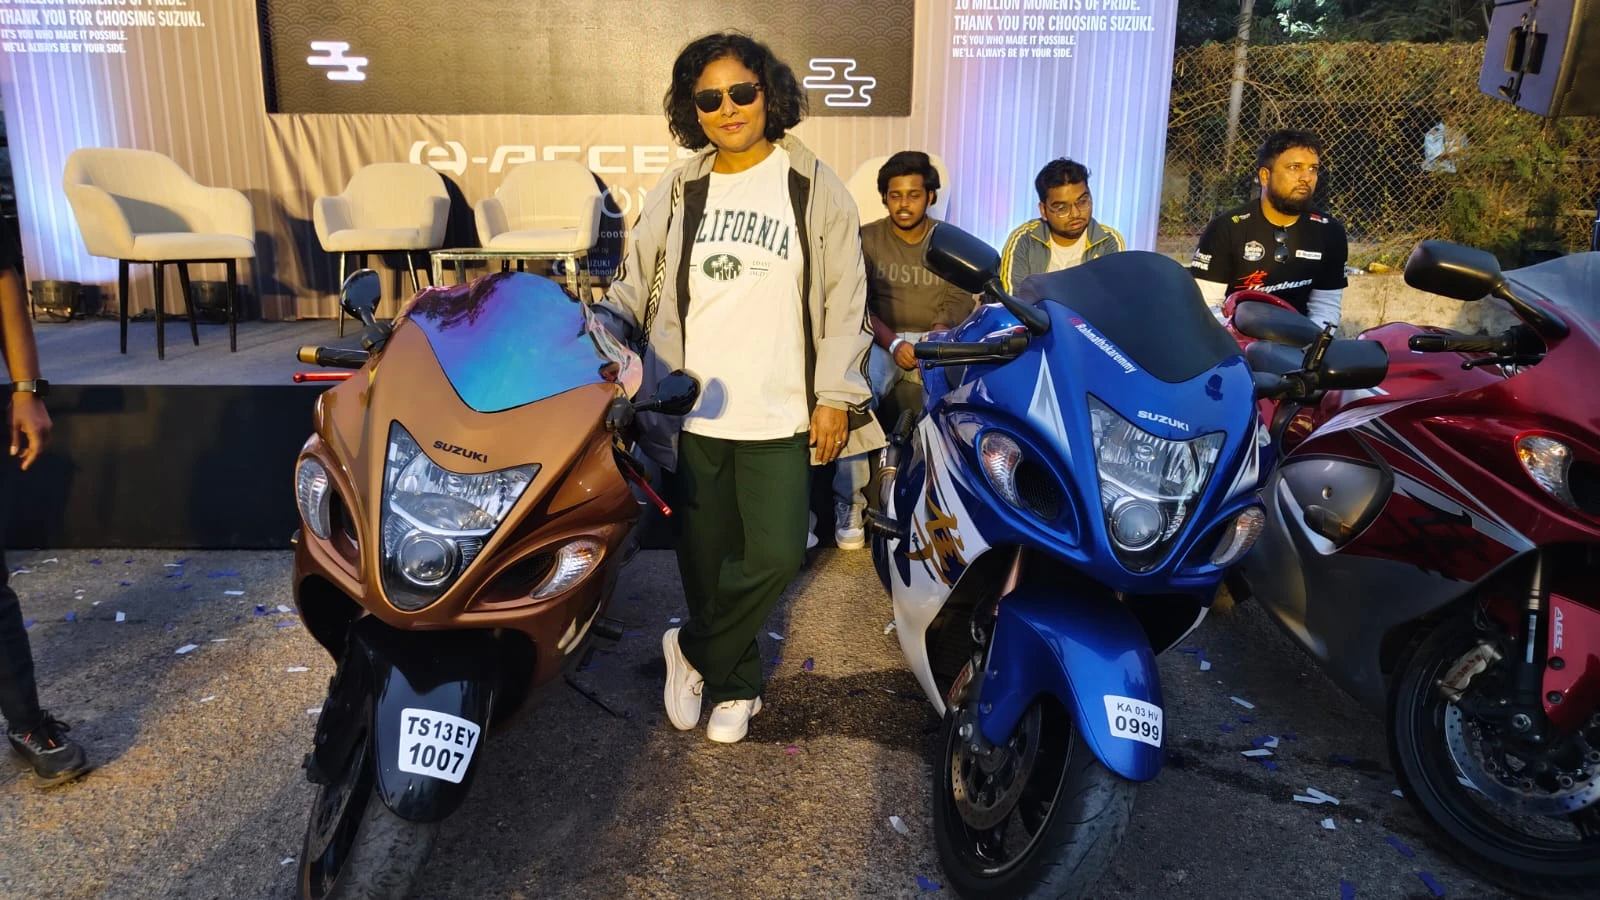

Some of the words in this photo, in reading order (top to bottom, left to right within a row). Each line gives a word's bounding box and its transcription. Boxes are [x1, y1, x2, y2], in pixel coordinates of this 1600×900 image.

[972, 0, 1020, 10] MILLION
[1023, 0, 1081, 10] MOMENTS
[0, 9, 40, 25] THANK
[41, 9, 67, 25] YOU
[68, 10, 93, 26] FOR
[95, 10, 155, 26] CHOOSING
[158, 11, 205, 27] SUZUKI.
[954, 15, 993, 31] THANK
[997, 15, 1019, 31] YOU
[1023, 15, 1045, 31] FOR
[1049, 15, 1107, 31] CHOOSING
[1110, 16, 1155, 31] SUZUKI.
[1, 29, 17, 39] IT'S
[17, 30, 34, 40] YOU
[35, 30, 54, 40] WHO
[55, 30, 79, 40] MADE
[80, 31, 87, 40] IT
[89, 31, 128, 41] POSSIBLE.
[952, 35, 967, 45] IT'S
[969, 35, 984, 45] YOU
[986, 35, 1004, 45] WHO
[1005, 35, 1028, 45] MADE
[1029, 35, 1036, 45] IT
[1038, 35, 1077, 45] POSSIBLE.
[3, 42, 26, 52] WE'LL
[28, 43, 59, 53] ALWAYS
[84, 43, 105, 53] YOUR
[106, 43, 127, 53] SIDE.
[952, 48, 975, 58] WE'LL
[976, 48, 1006, 58] ALWAYS
[1007, 48, 1018, 58] BE
[1019, 48, 1030, 58] BY
[1031, 48, 1052, 58] YOUR
[1053, 48, 1073, 58] SIDE.
[1137, 410, 1190, 432] SUZUKI
[433, 440, 488, 464] SUZUKI
[1553, 606, 1564, 652] ABS
[1117, 702, 1132, 713] KA
[1135, 706, 1146, 717] 03
[1115, 715, 1159, 741] 0999
[409, 743, 464, 774] 1007
